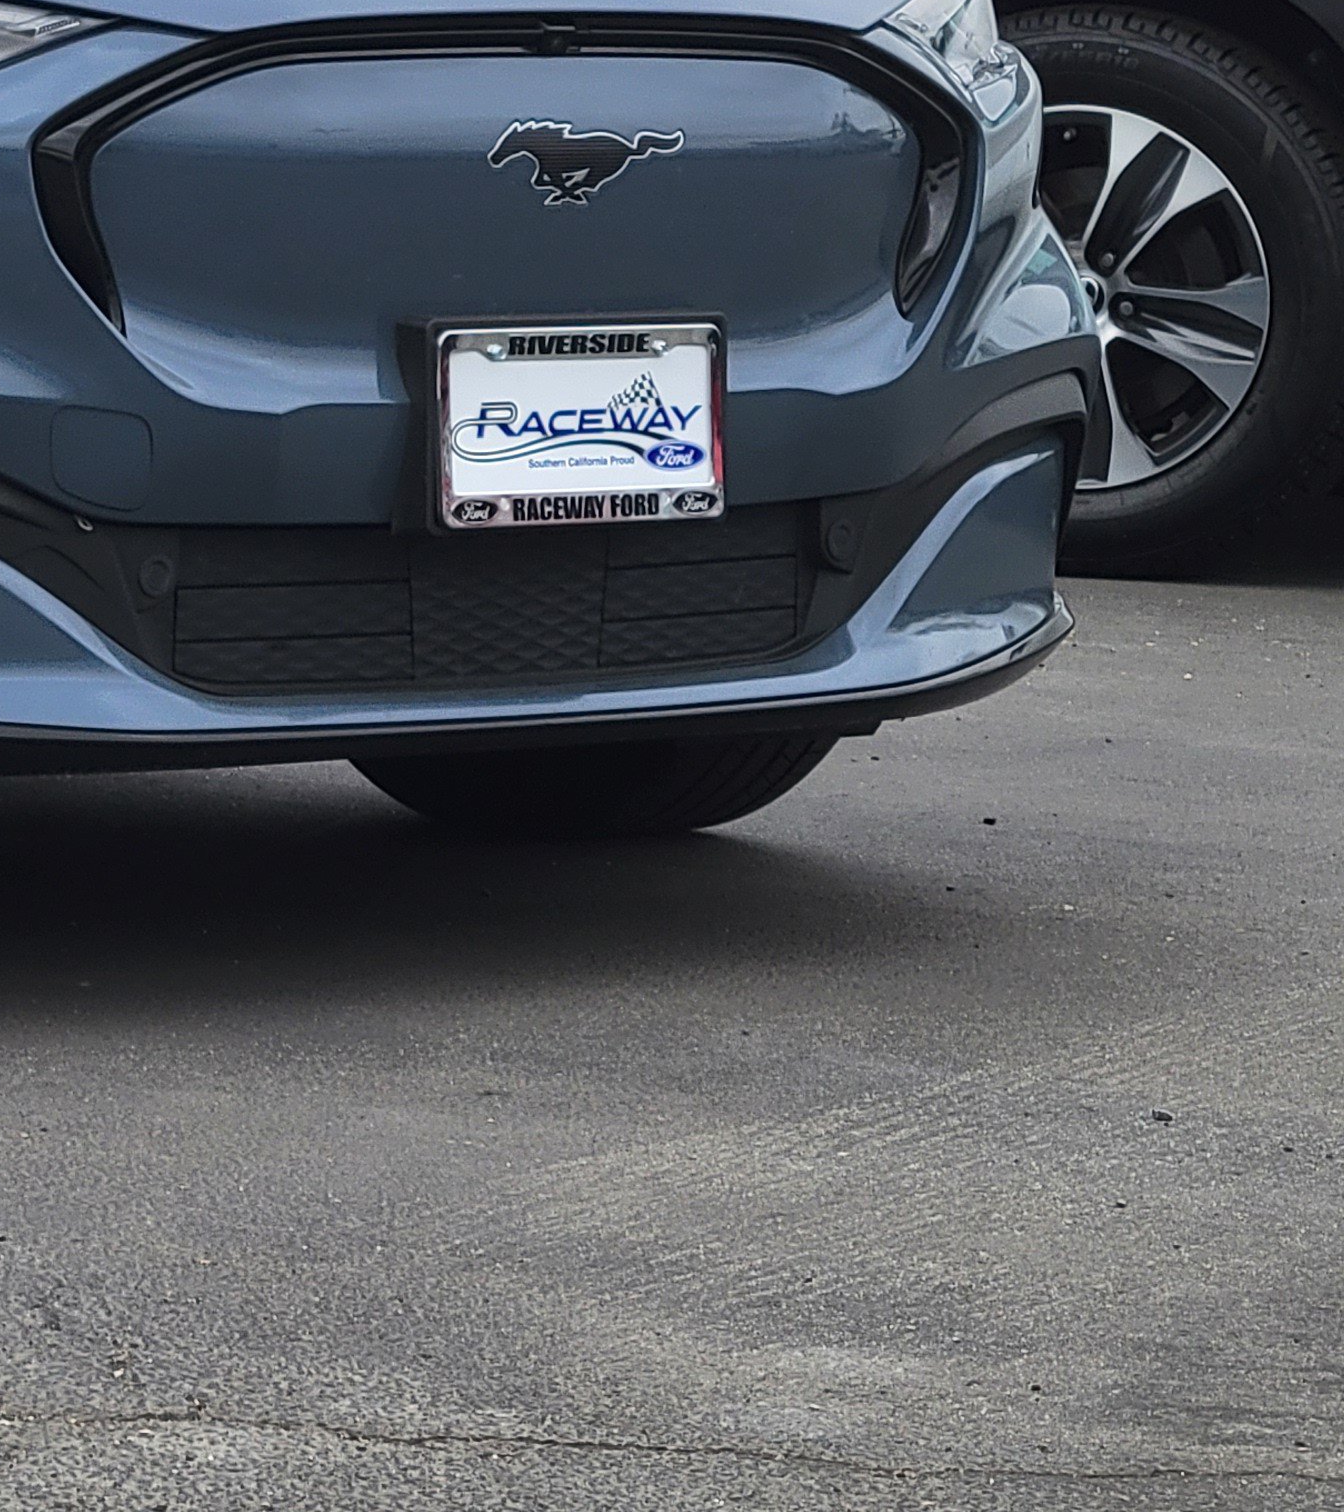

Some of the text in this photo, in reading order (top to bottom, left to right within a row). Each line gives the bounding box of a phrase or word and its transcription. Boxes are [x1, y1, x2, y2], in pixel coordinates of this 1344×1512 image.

[508, 333, 651, 356] RIVERSIDE
[477, 401, 702, 438] RACEWAY
[528, 455, 635, 469] Southern California Proud
[655, 444, 695, 466] Ford
[462, 500, 491, 520] Ford
[513, 493, 659, 522] RACEWAY FORD
[682, 493, 710, 511] Ford
